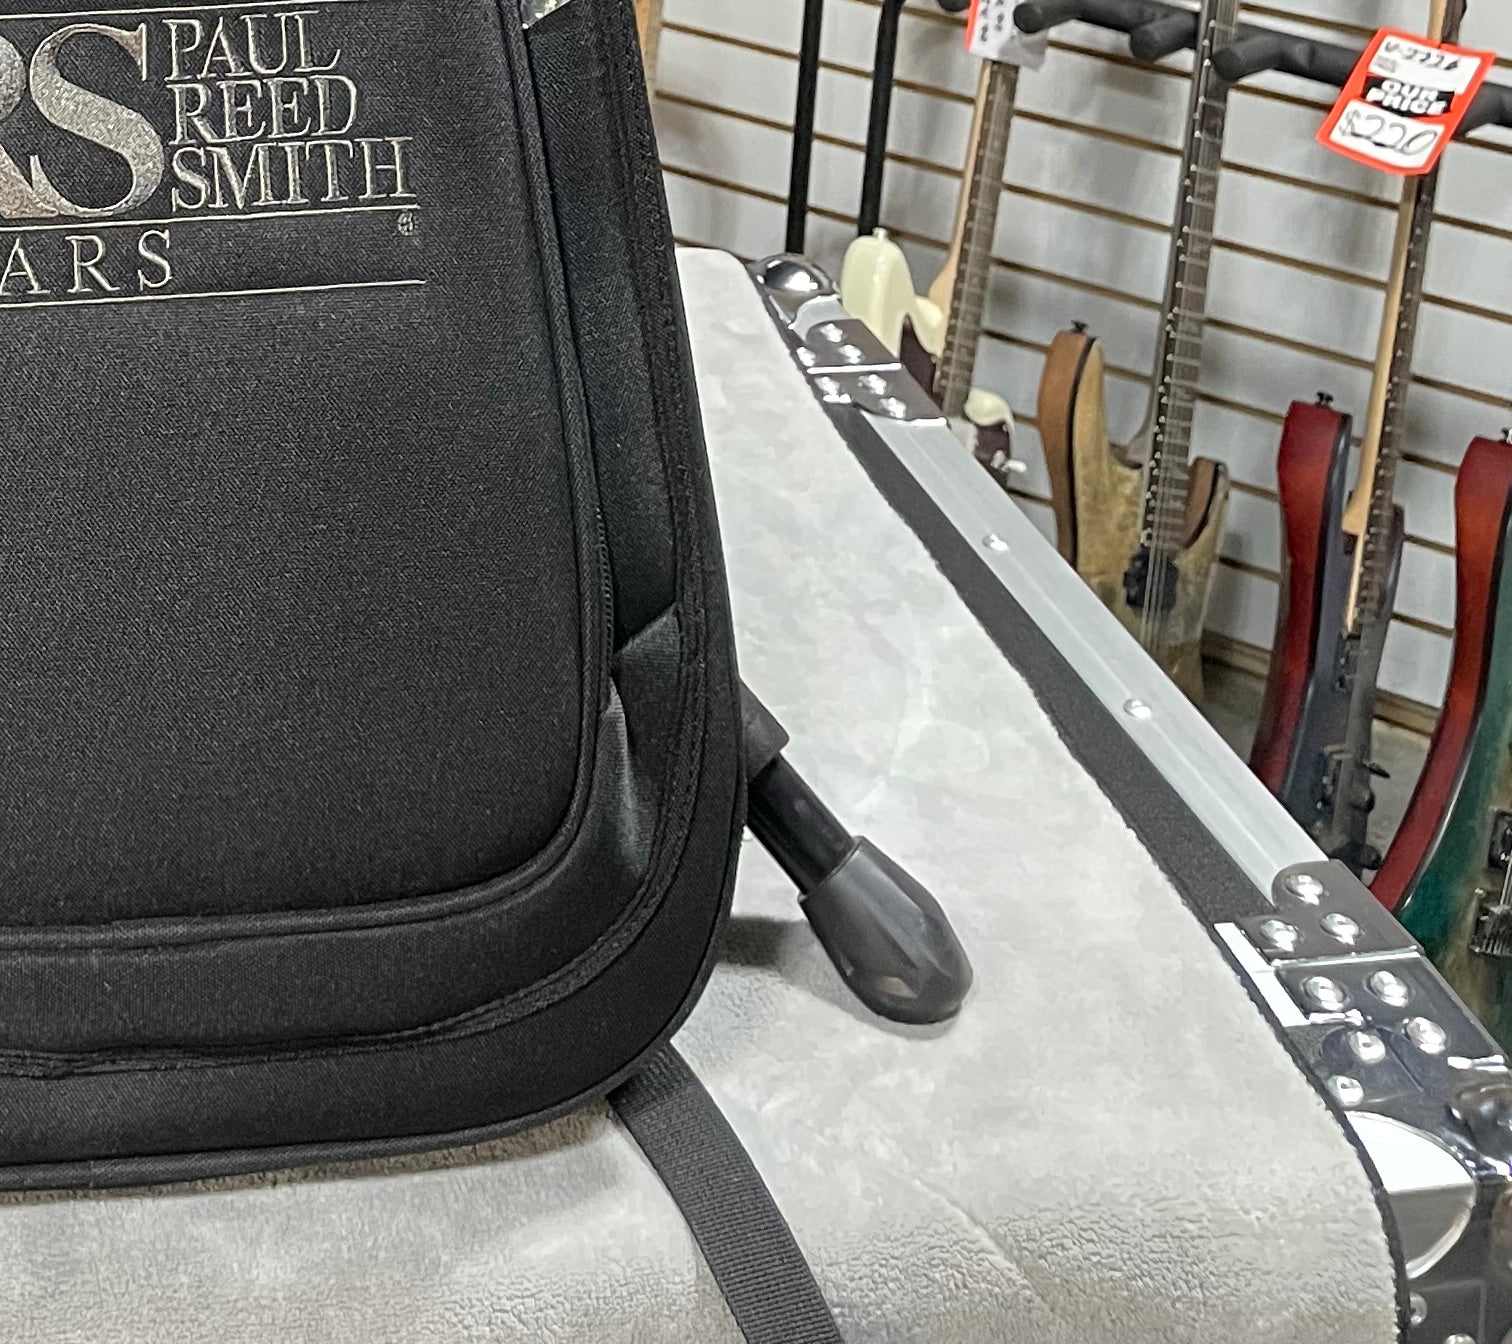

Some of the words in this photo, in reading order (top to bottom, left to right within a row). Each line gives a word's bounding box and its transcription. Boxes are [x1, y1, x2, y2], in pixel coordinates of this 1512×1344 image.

[164, 10, 341, 83] PAUL
[166, 75, 358, 145] REED
[1365, 87, 1448, 116] PRICE
[1381, 78, 1439, 102] OUR
[1339, 109, 1438, 156] $220
[171, 137, 417, 214] SMITH
